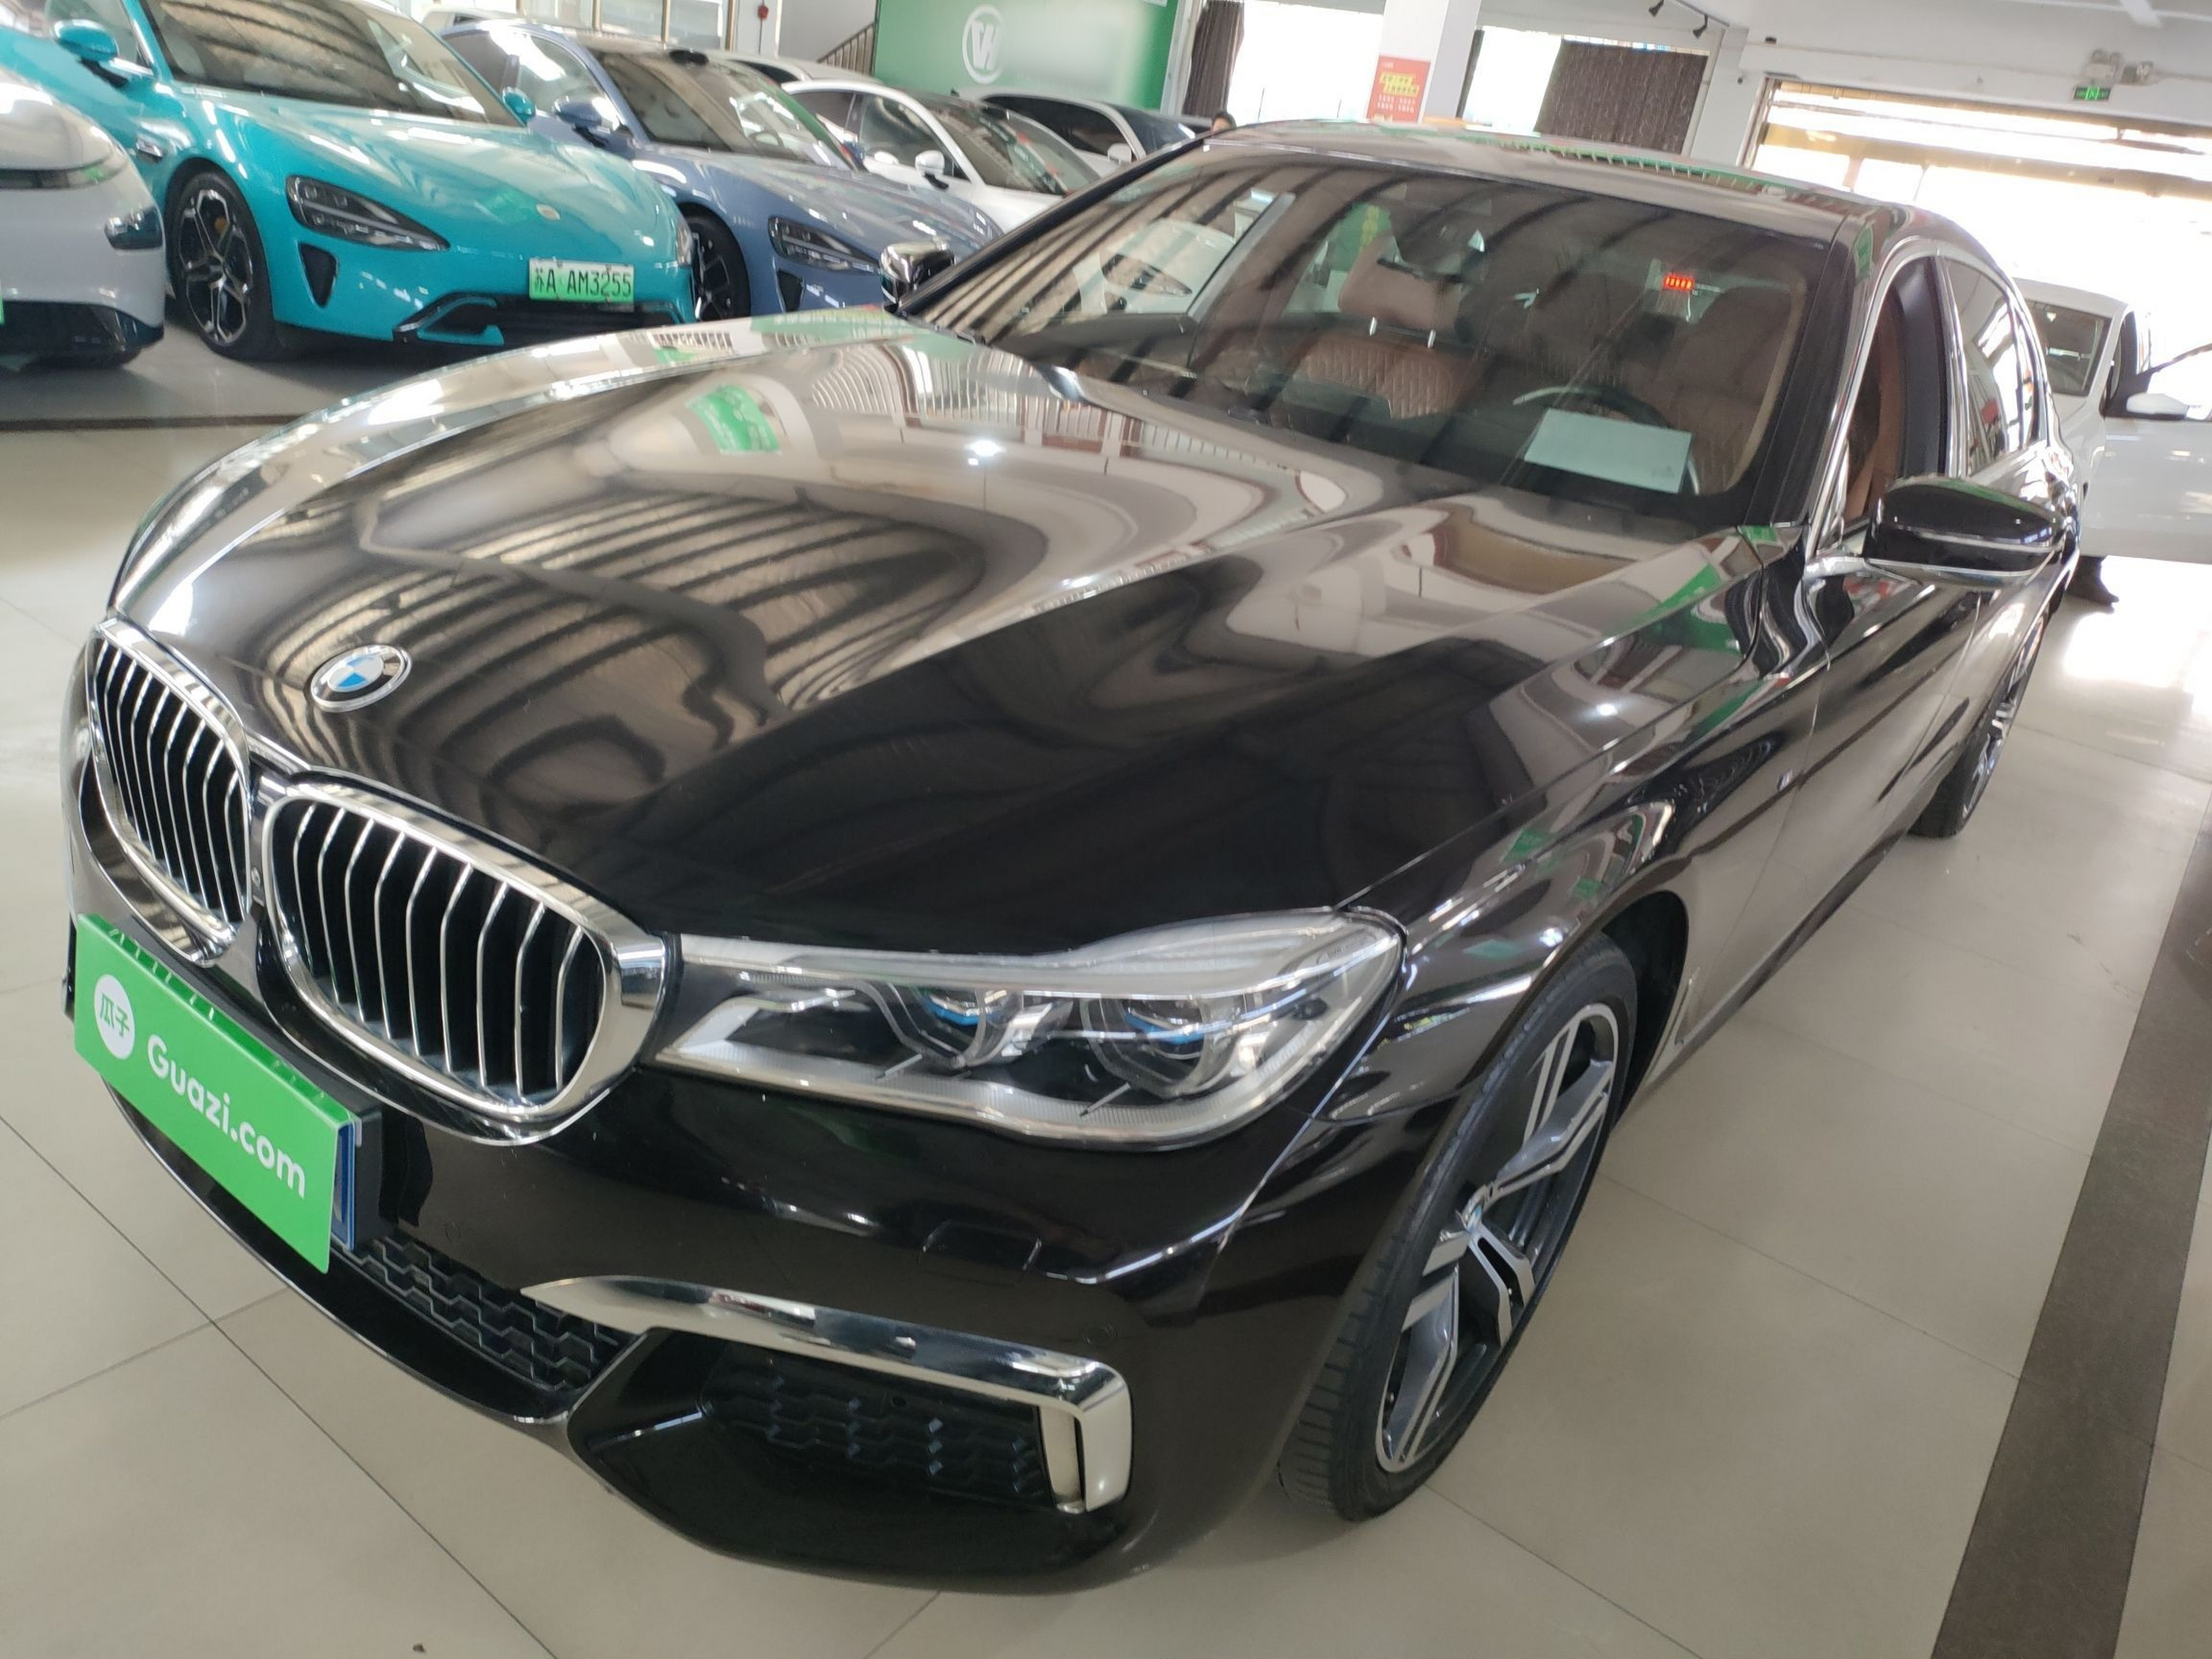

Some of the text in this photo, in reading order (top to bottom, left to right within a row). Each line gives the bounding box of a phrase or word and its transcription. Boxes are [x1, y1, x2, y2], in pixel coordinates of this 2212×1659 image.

[567, 270, 631, 297] AM3255
[100, 994, 131, 1037] 瓜子
[147, 1034, 305, 1198] Guazi.com
